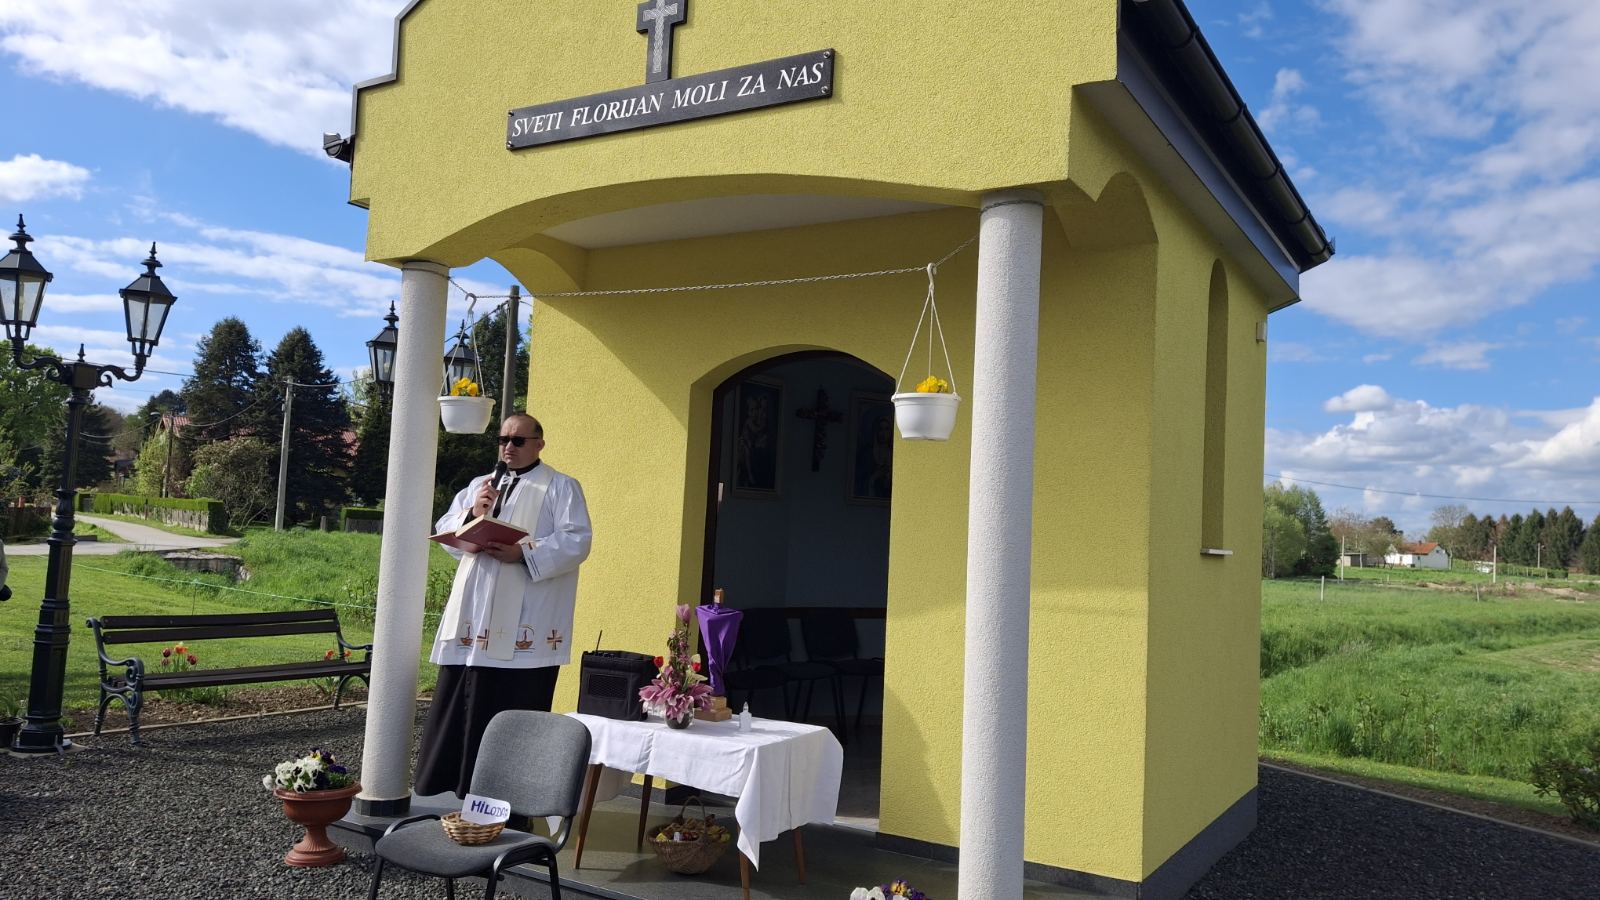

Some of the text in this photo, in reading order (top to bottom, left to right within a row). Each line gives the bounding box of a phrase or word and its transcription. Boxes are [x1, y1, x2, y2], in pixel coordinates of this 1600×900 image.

[512, 62, 824, 138] SVETI FLORIJAN MOLI ZA NAS
